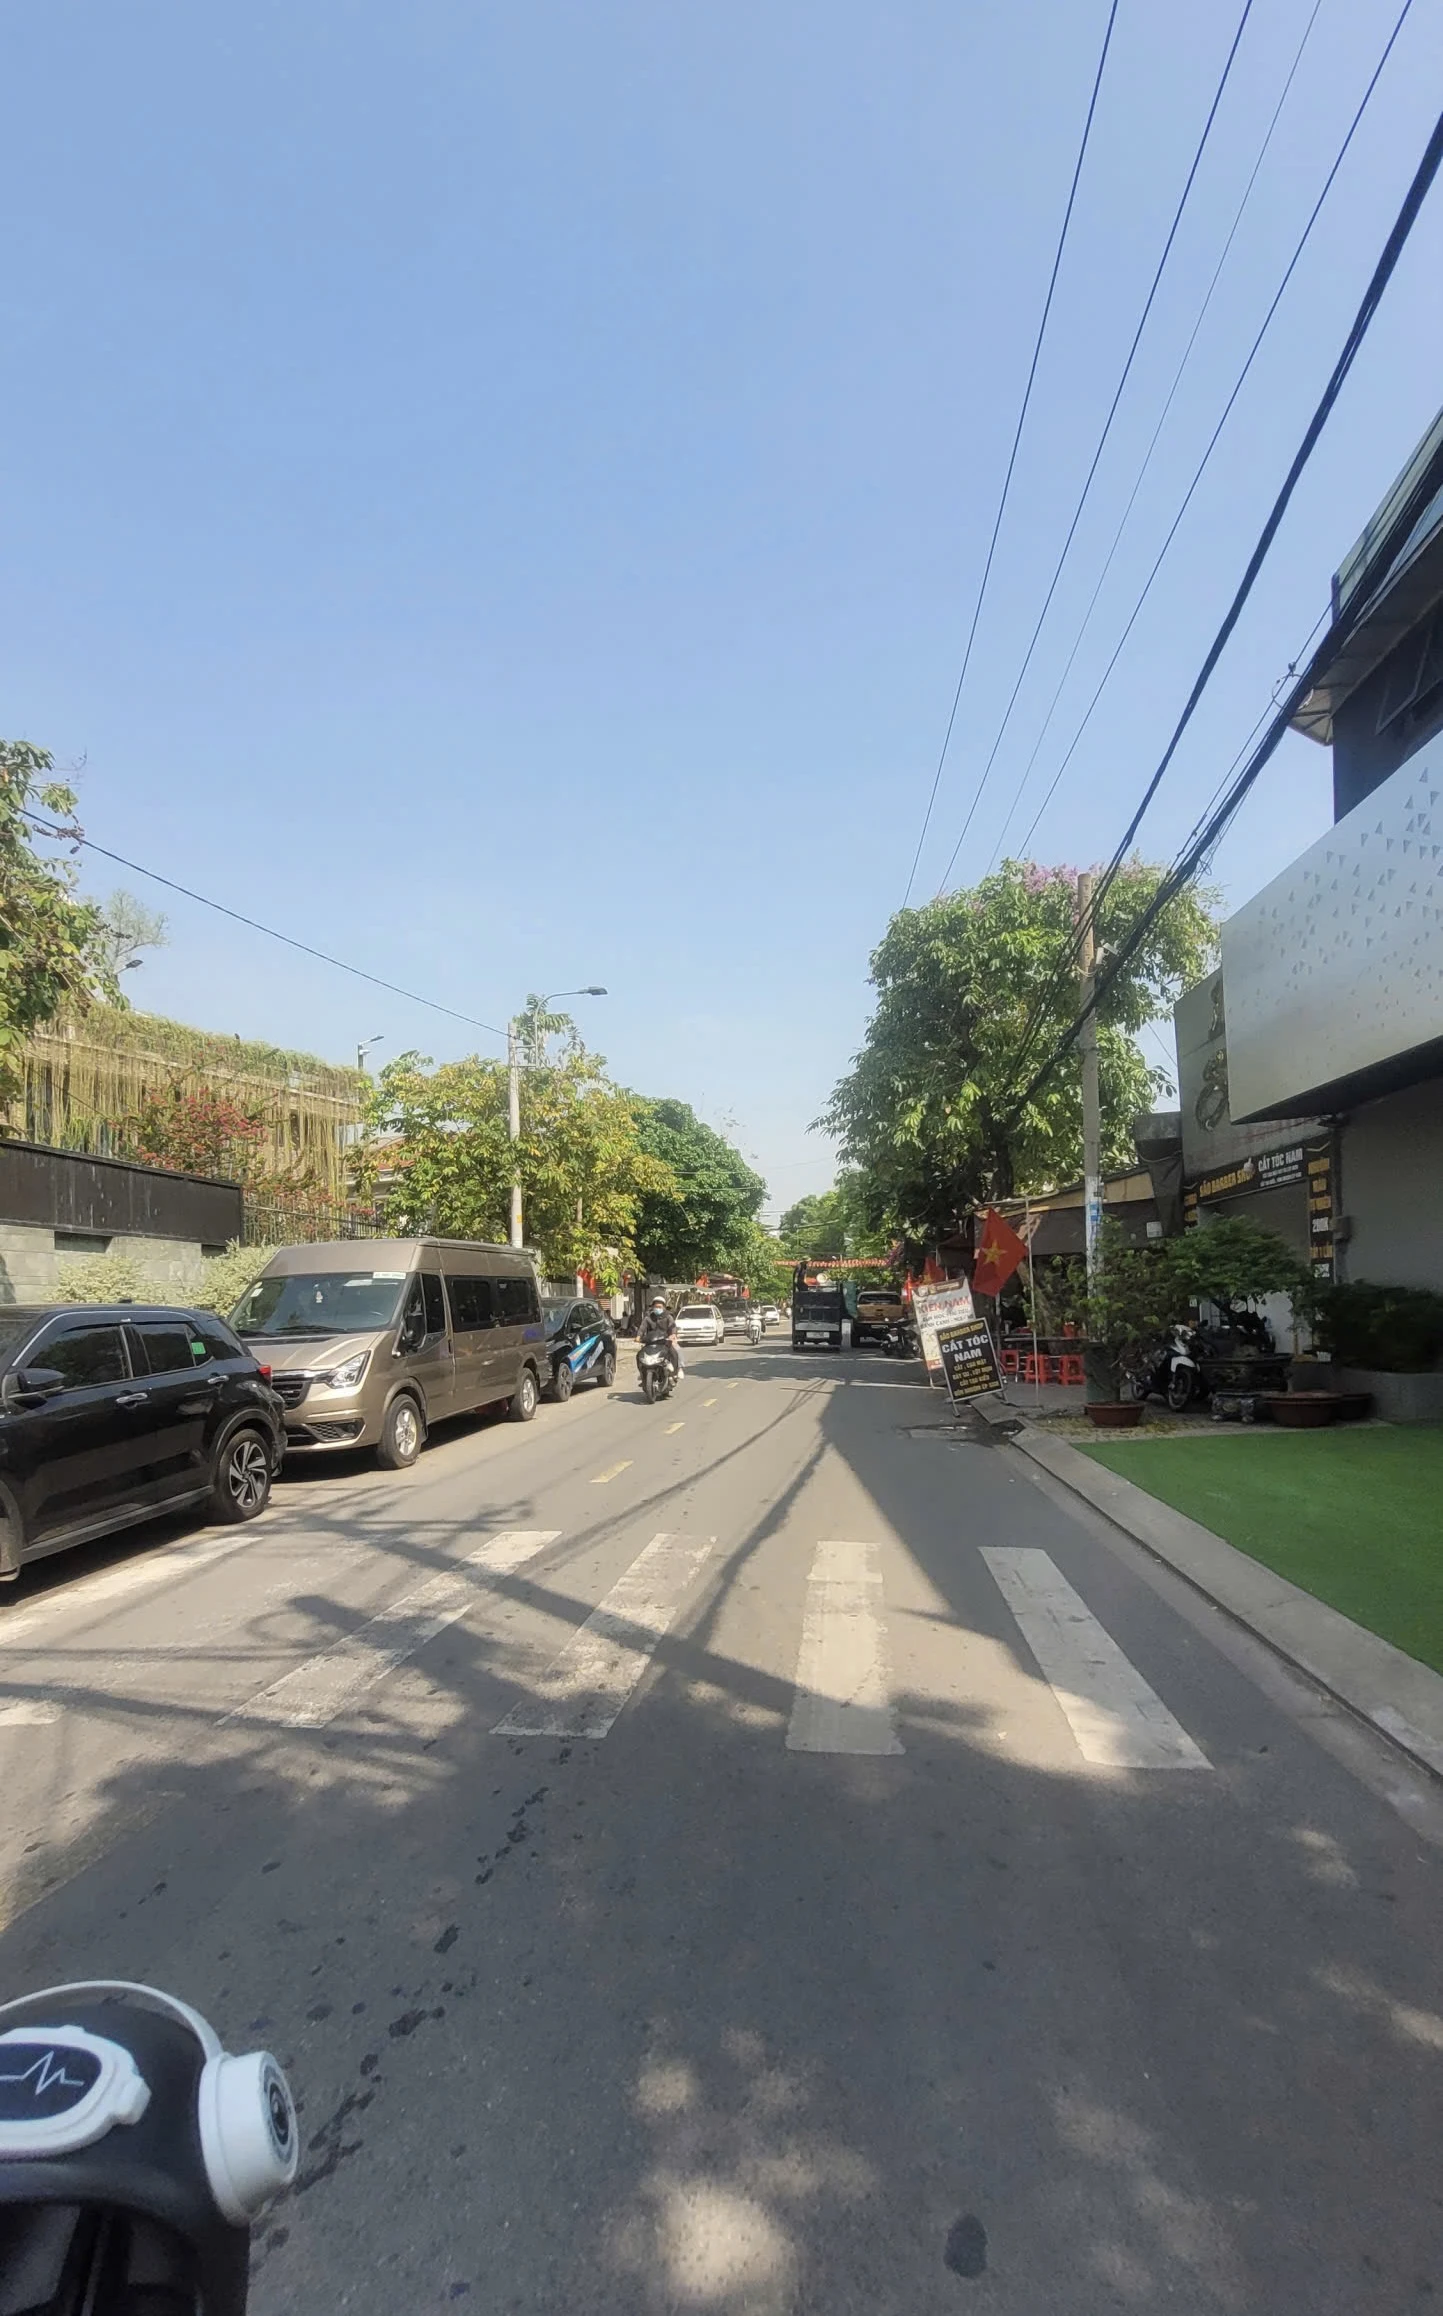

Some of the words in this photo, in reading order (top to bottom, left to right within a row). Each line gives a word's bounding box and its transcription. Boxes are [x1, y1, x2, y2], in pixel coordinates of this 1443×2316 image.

[1285, 1148, 1303, 1164] NAM
[942, 1338, 963, 1353] CẮT
[966, 1334, 989, 1347] TÓC
[954, 1348, 982, 1362] NAM
